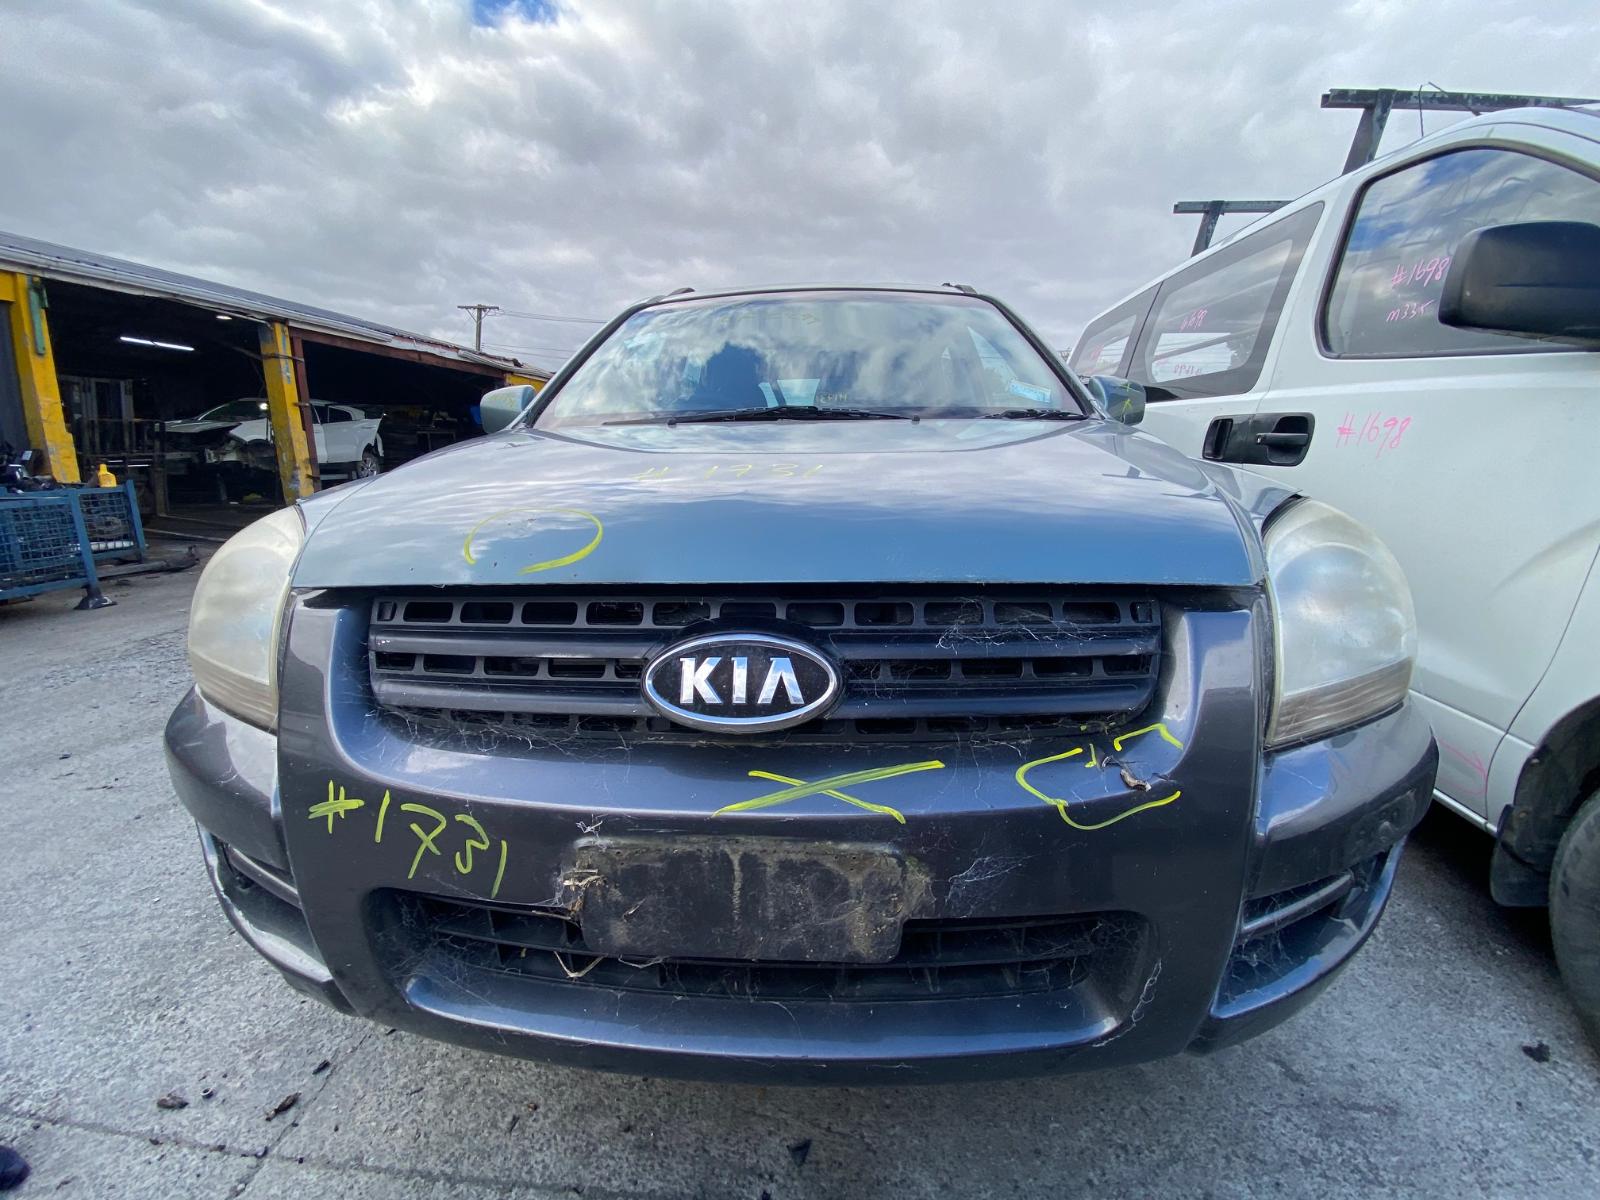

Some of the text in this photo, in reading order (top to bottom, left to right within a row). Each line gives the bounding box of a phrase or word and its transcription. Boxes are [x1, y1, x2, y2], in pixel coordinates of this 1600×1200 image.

[1391, 255, 1450, 287] #1698
[1336, 411, 1412, 459] #1698
[680, 656, 805, 705] KIA
